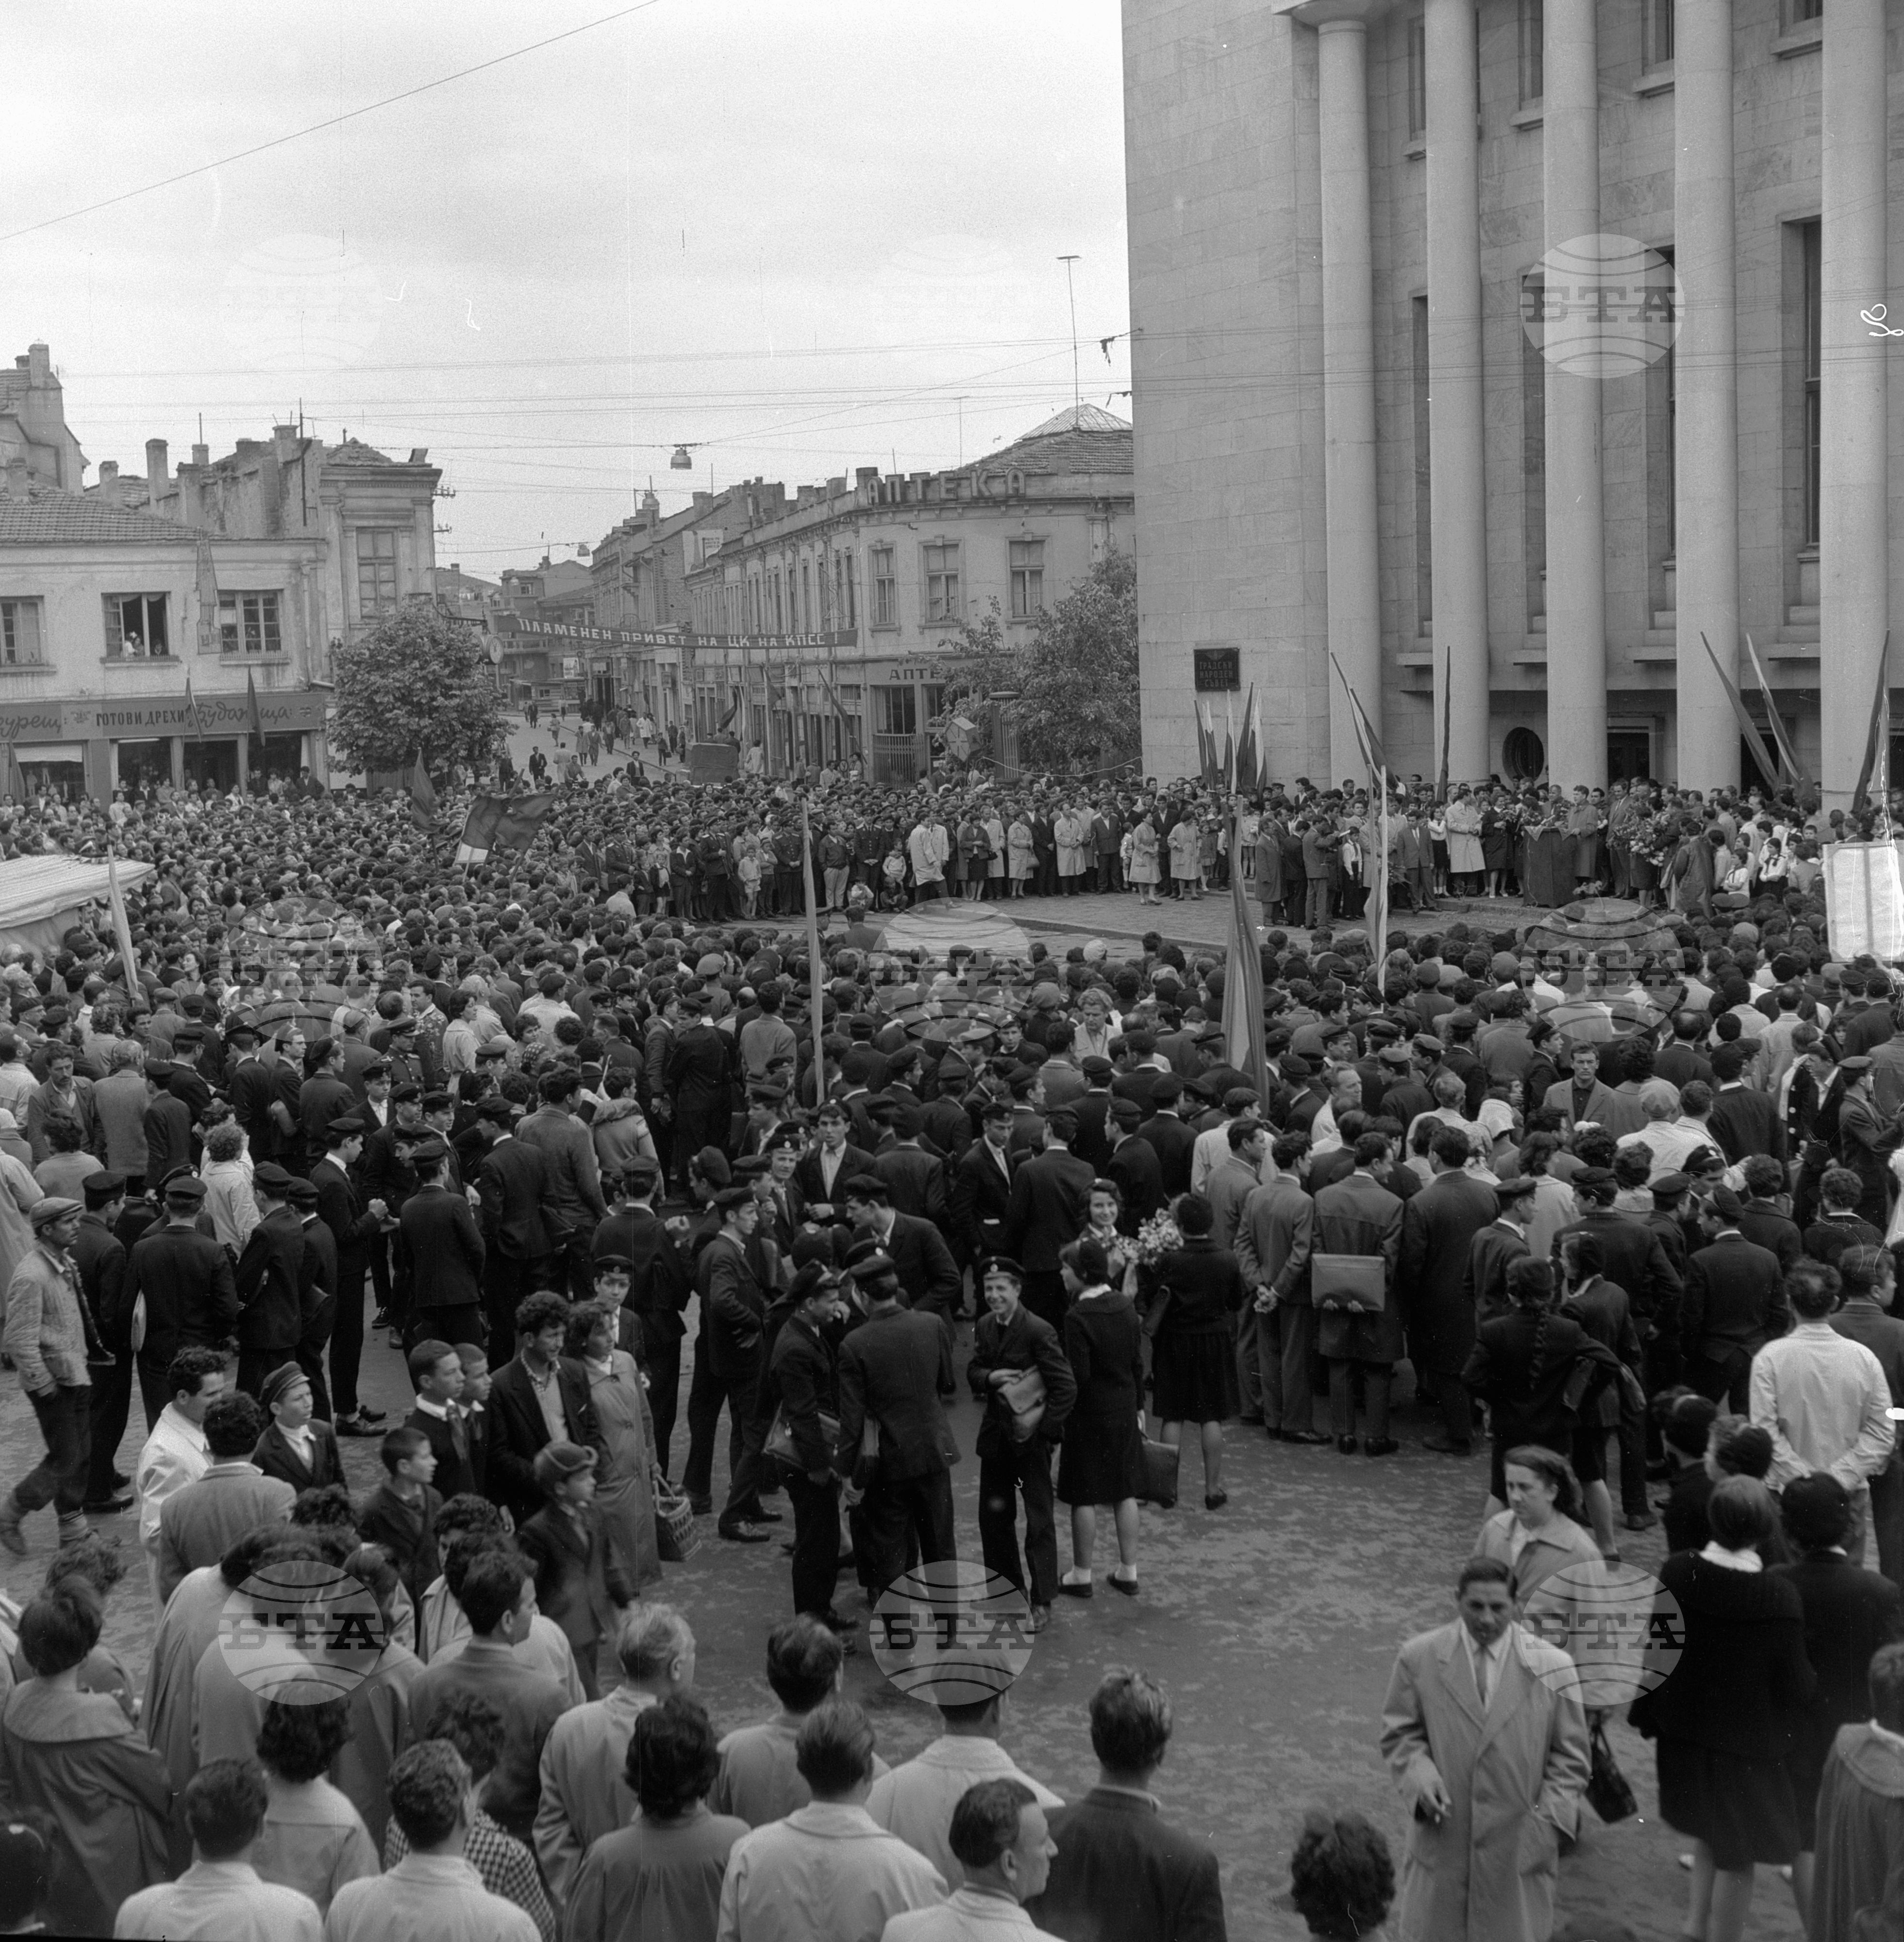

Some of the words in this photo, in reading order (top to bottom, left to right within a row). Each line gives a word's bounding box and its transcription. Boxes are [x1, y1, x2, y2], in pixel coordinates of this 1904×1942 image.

[867, 468, 1026, 504] АПТЕКА
[518, 619, 612, 640] ПЛАМЕНЕН
[620, 632, 686, 645] ПРИВЕТ
[698, 636, 718, 646] НА
[728, 636, 750, 648] ЦК
[758, 637, 777, 646] НА
[785, 633, 825, 646] КПСС
[1200, 661, 1233, 670] ГРАДСКИ
[1200, 670, 1234, 678] НАРОДЕН
[1204, 679, 1229, 687] СЪВЕТ
[96, 712, 142, 727] ГОТОВИ
[145, 710, 184, 727] ДРЕХИ
